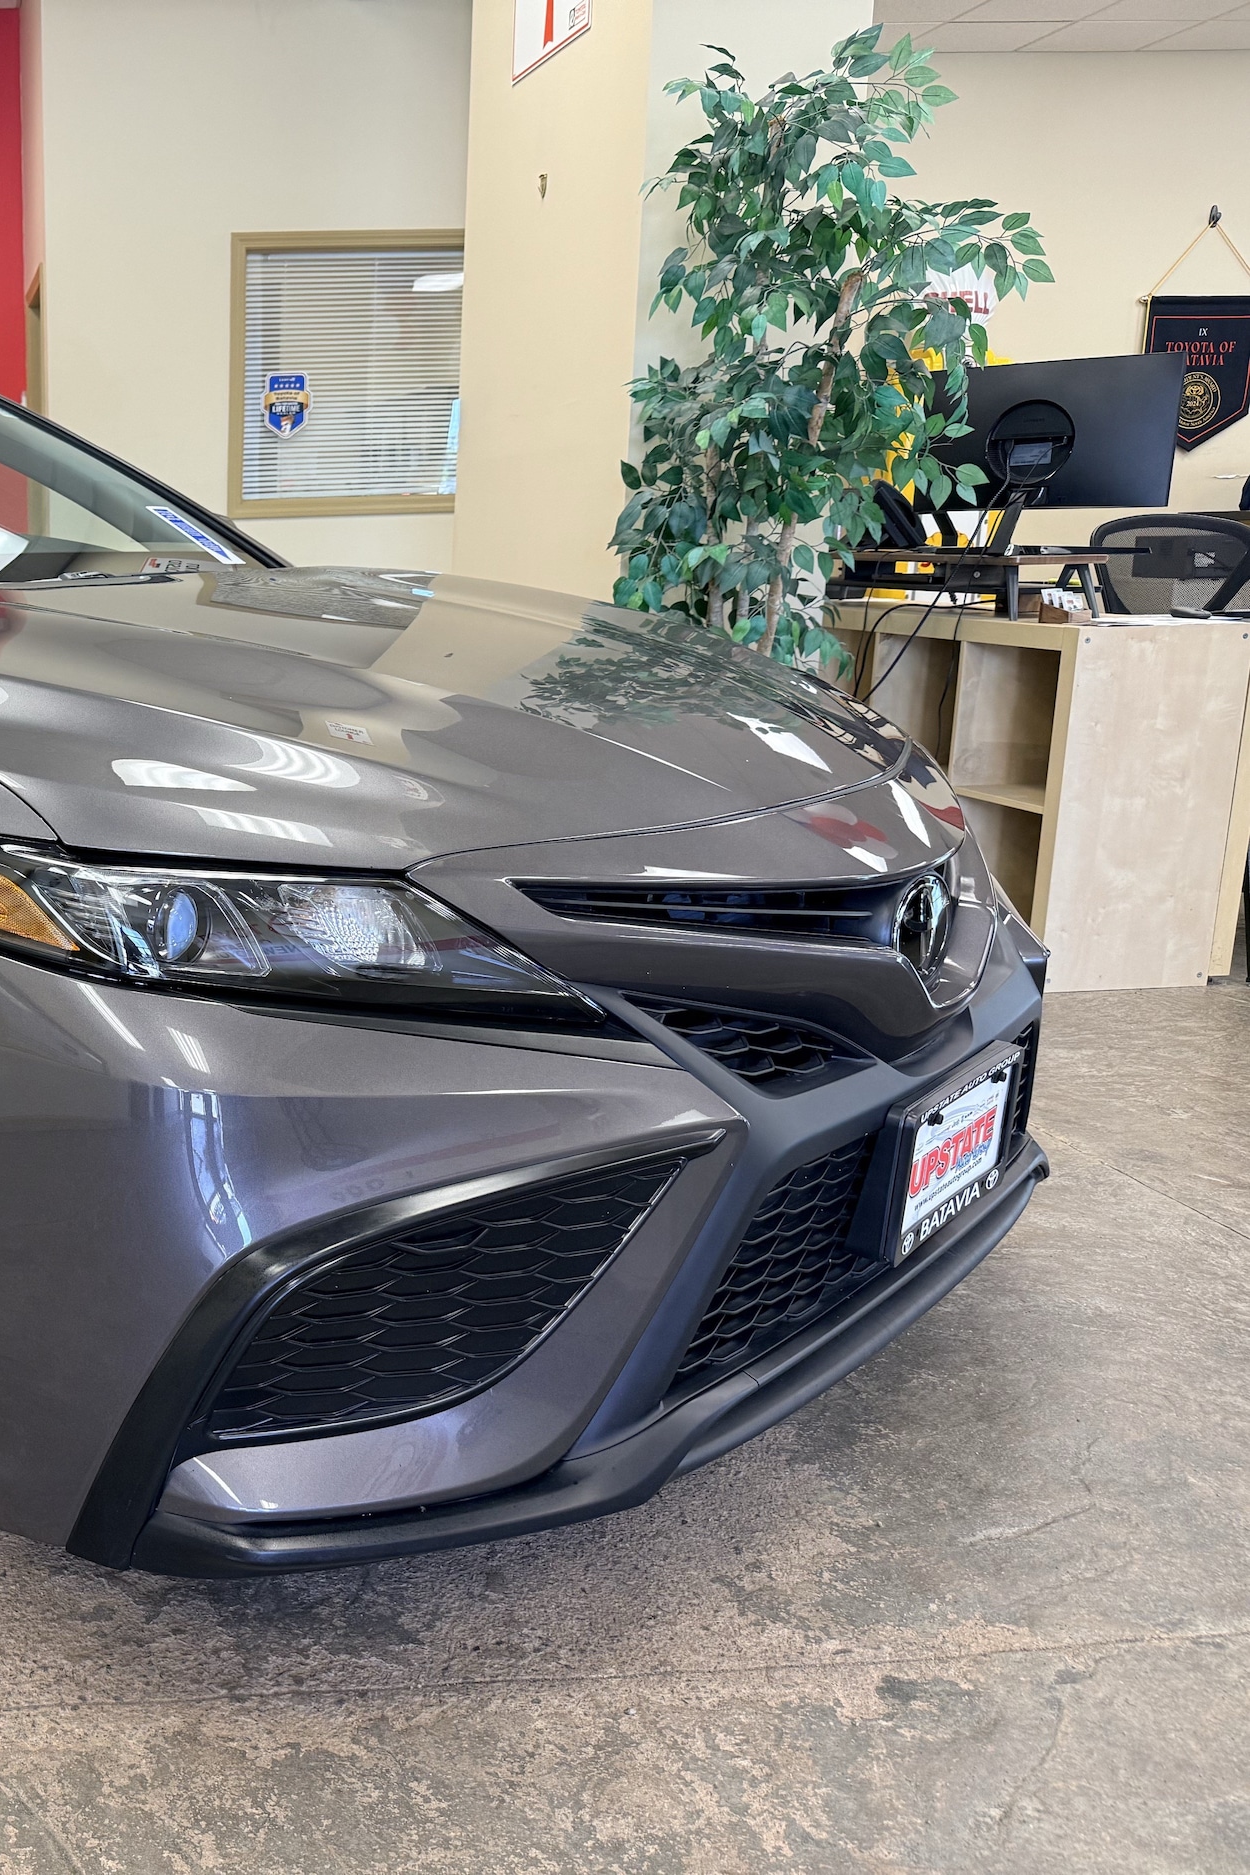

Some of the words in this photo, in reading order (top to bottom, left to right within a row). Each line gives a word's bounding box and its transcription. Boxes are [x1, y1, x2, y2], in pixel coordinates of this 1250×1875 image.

[1165, 341, 1215, 353] TOYOTA
[1219, 341, 1237, 353] OF
[1198, 327, 1209, 337] IX
[271, 405, 301, 413] LIFETIME
[920, 1088, 962, 1124] UPSTATE
[961, 1072, 988, 1095] AUTO
[988, 1051, 1021, 1076] GROUP
[909, 1104, 998, 1198] UPSTATE
[919, 1182, 981, 1242] BATAVIA
